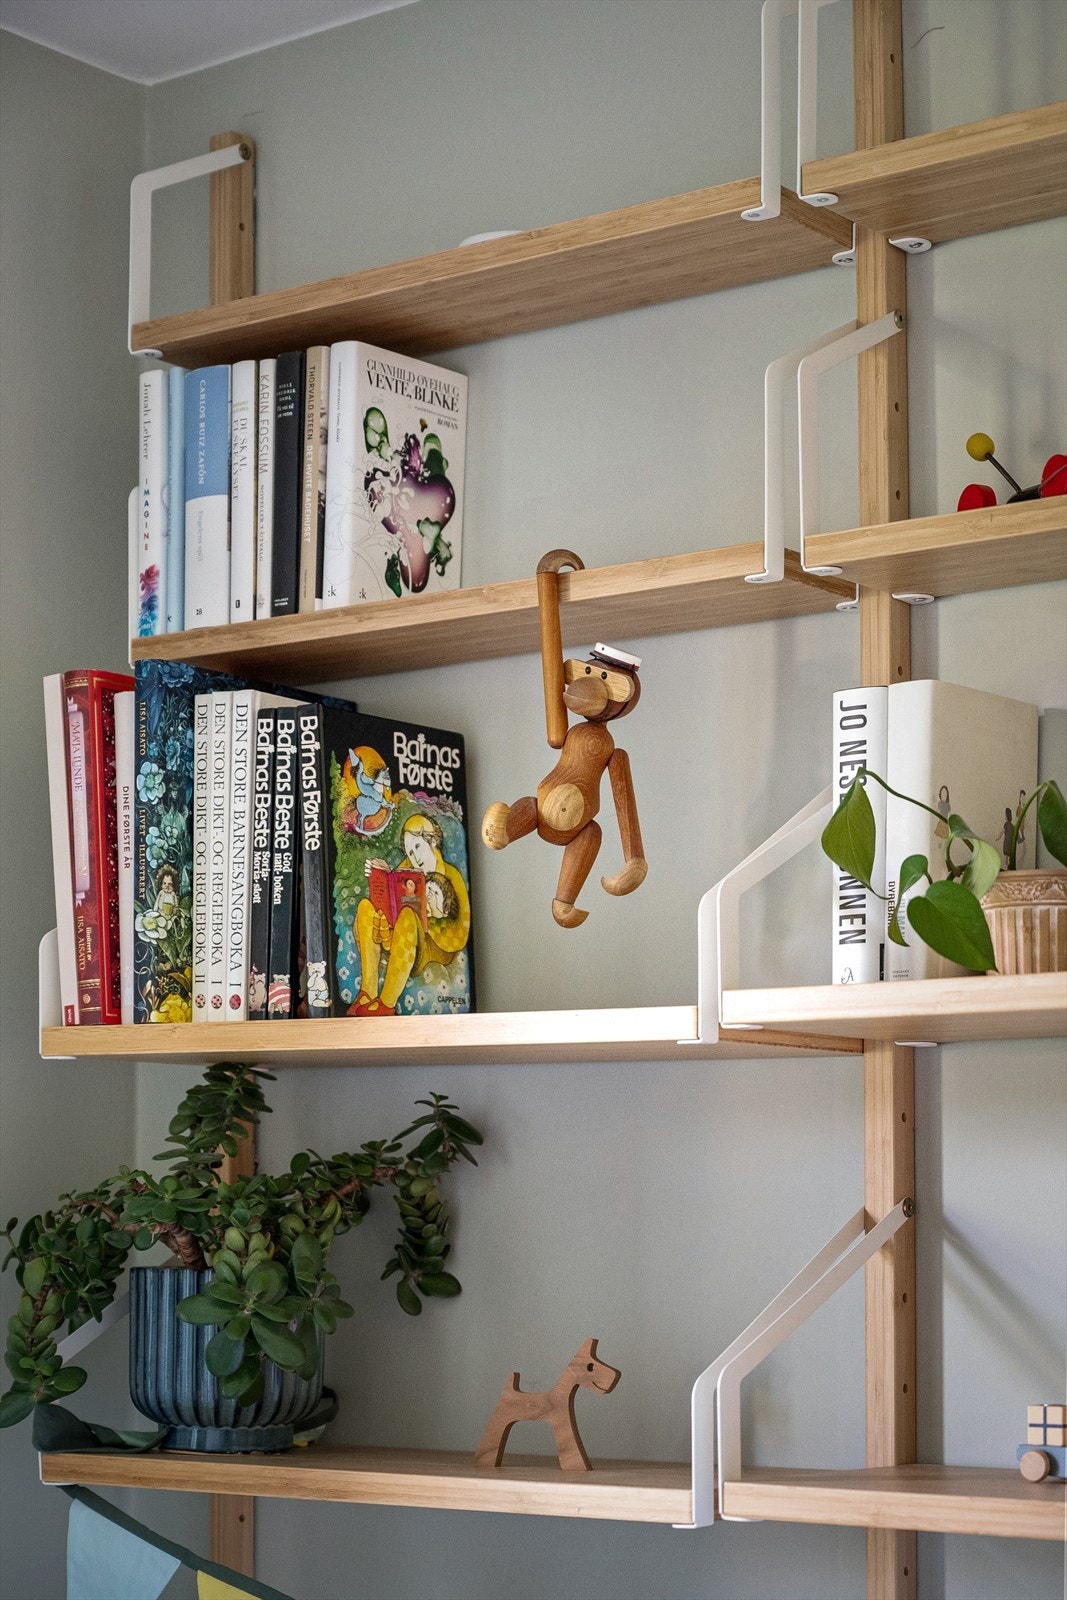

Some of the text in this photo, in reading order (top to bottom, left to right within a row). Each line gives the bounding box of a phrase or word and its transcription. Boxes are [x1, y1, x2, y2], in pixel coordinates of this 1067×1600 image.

[307, 365, 316, 410] THORVALD
[366, 358, 459, 397] GUNNHILD ØYEHAUG
[367, 370, 459, 413] VENTE, BLINKE
[143, 383, 152, 460] Jonah Lehrer
[259, 375, 270, 474] KARIN FOSSUM
[198, 450, 207, 484] ZAFÓN
[304, 464, 312, 489] HVITE
[303, 492, 312, 542] BADEHUSET
[214, 702, 225, 734] DEN
[235, 704, 247, 742] DEN
[839, 700, 868, 730] JO
[213, 740, 225, 790] STORE
[393, 731, 460, 769] Barnas
[72, 756, 82, 792] LUNDE
[233, 748, 247, 804] STORE
[254, 718, 275, 848] Barnas Beste
[274, 719, 298, 848] Barnas Beste
[299, 715, 322, 851] Barnas Første
[399, 755, 453, 792] Første
[839, 740, 868, 804] NES
[123, 815, 132, 853] FØRSTE
[194, 704, 208, 984] DEN STORE DIKT- OG REGLEBOKA II
[124, 856, 133, 869] ÅR
[212, 841, 224, 866] OG
[282, 853, 292, 873] God
[229, 810, 246, 972] BARNESANGBOKA
[211, 872, 223, 966] REGLEBOKA
[77, 936, 85, 970] AISATO
[86, 953, 91, 961] av
[437, 996, 466, 1005] CAPPELEN
